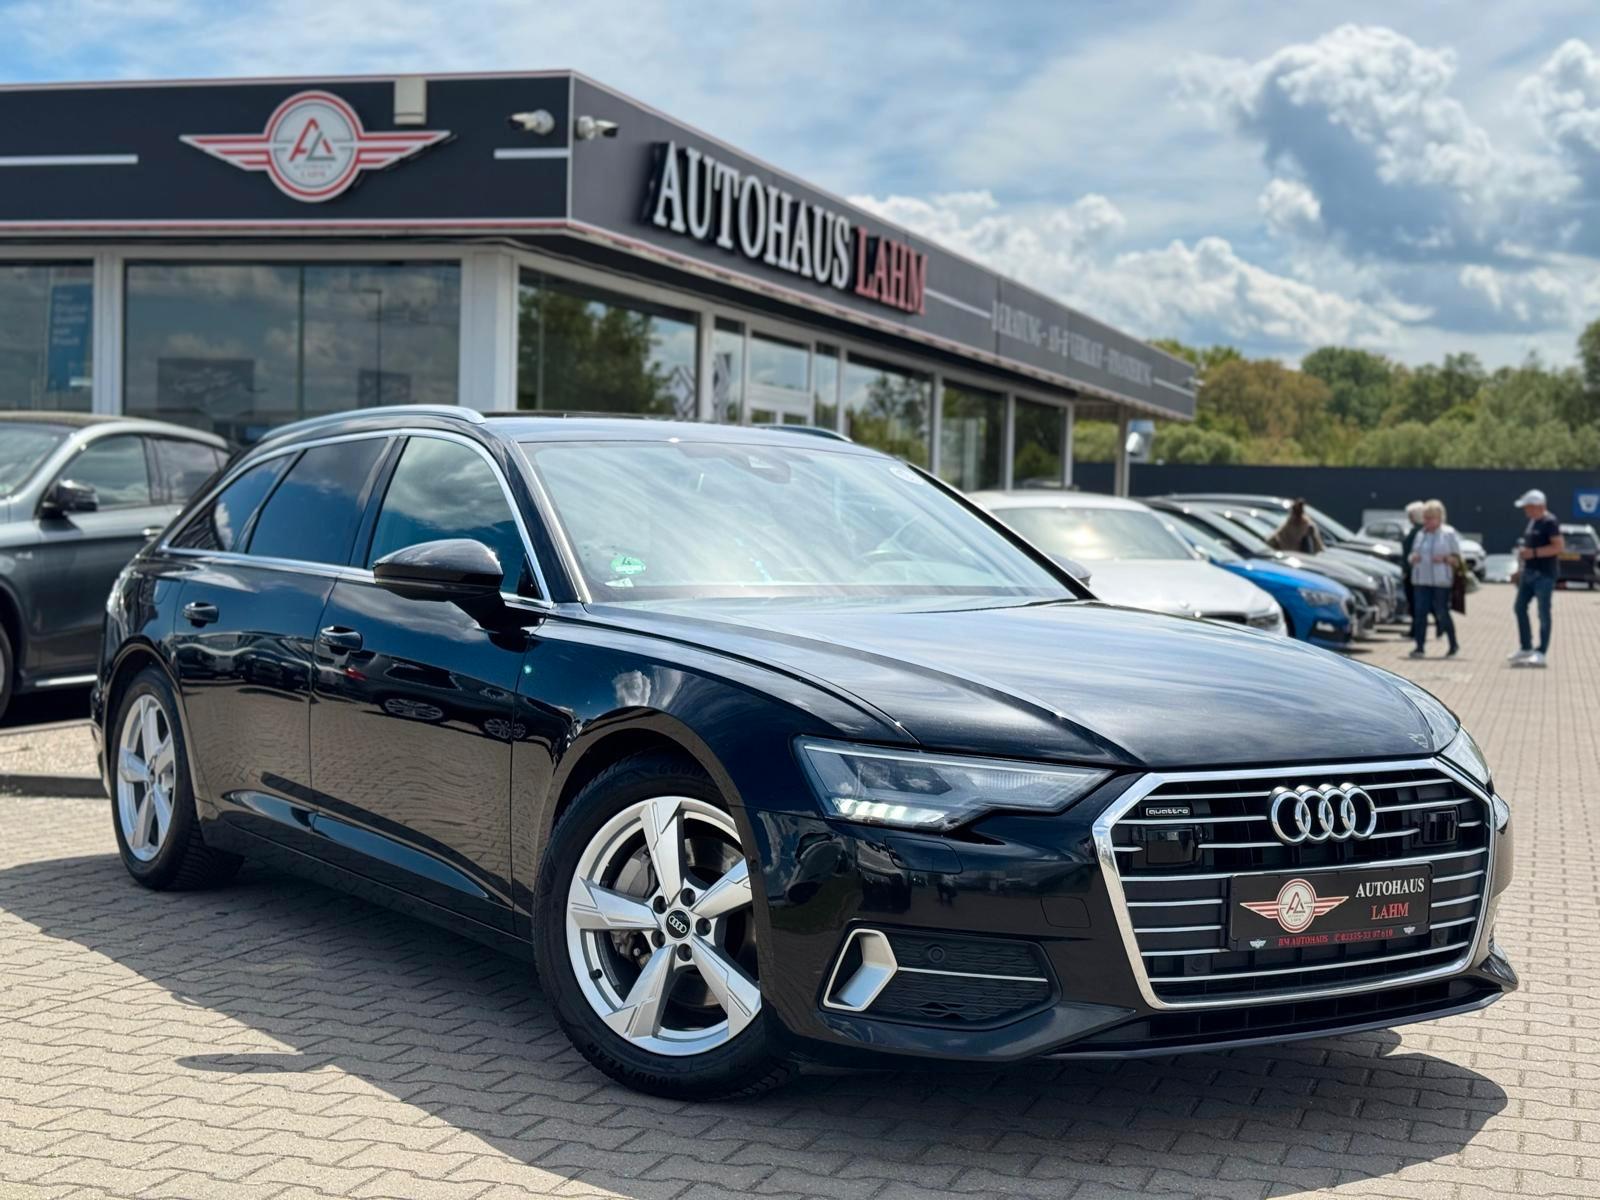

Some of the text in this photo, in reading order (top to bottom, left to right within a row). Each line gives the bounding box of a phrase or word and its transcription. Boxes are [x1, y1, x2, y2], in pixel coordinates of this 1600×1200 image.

[653, 140, 928, 316] AUTOHAUS LAHM
[1148, 807, 1189, 816] quattro
[1355, 877, 1425, 898] AUTOHAUS
[1371, 902, 1409, 920] LAHM
